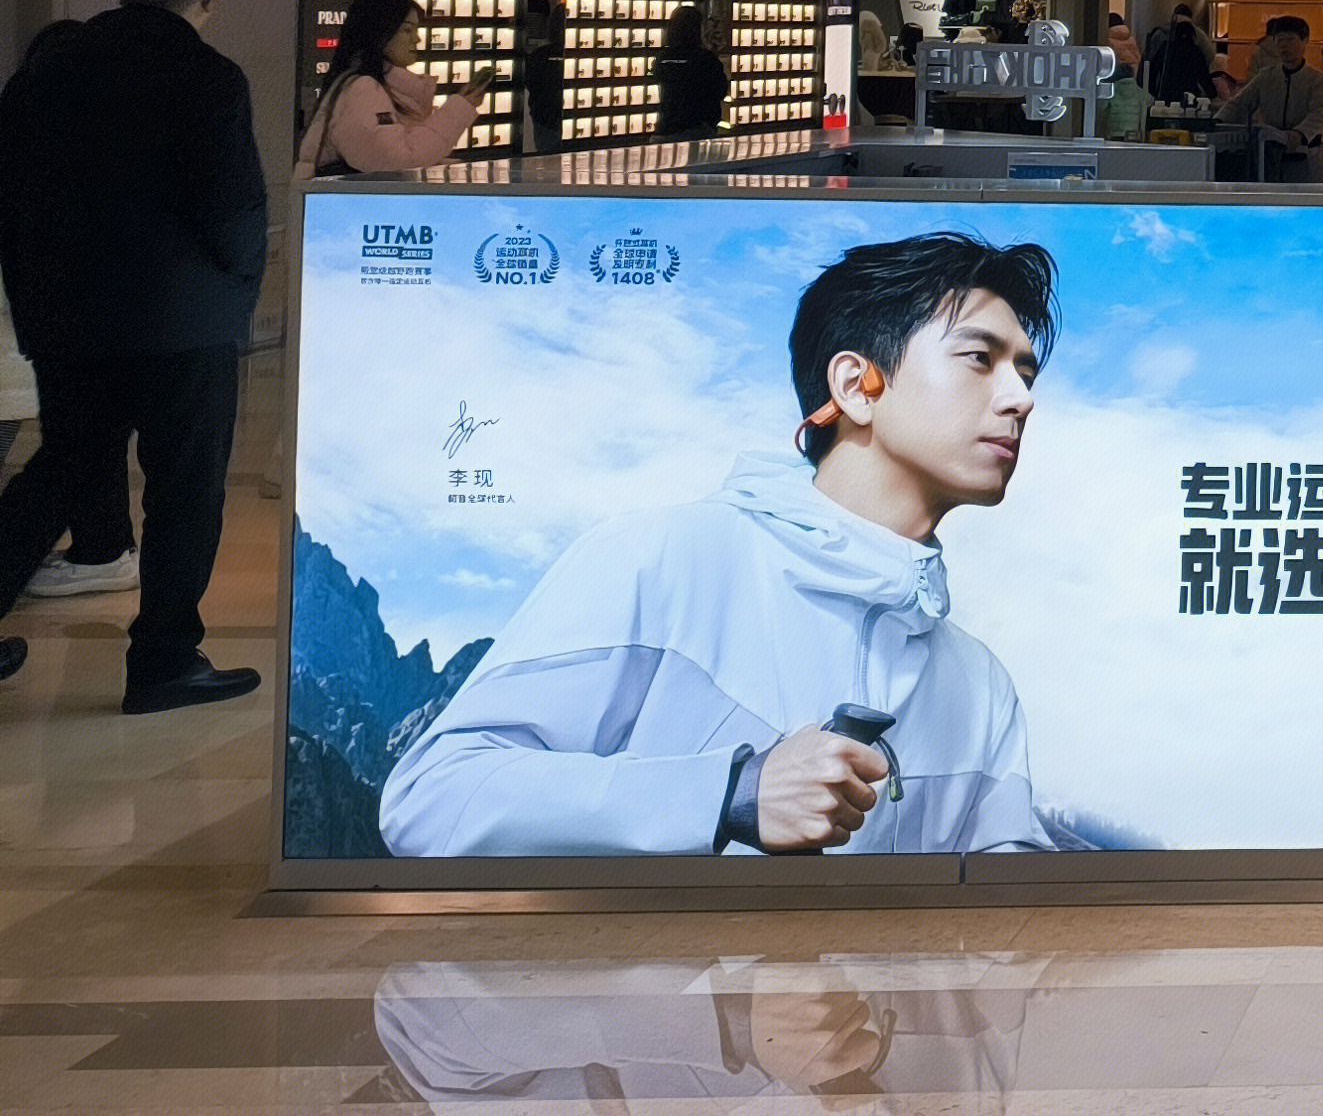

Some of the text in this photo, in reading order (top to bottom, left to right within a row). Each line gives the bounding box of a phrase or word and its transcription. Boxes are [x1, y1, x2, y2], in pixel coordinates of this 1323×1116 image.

[362, 224, 434, 245] UTMB
[505, 237, 532, 245] 2023
[495, 271, 537, 285] NO.1
[448, 469, 494, 488] 李现
